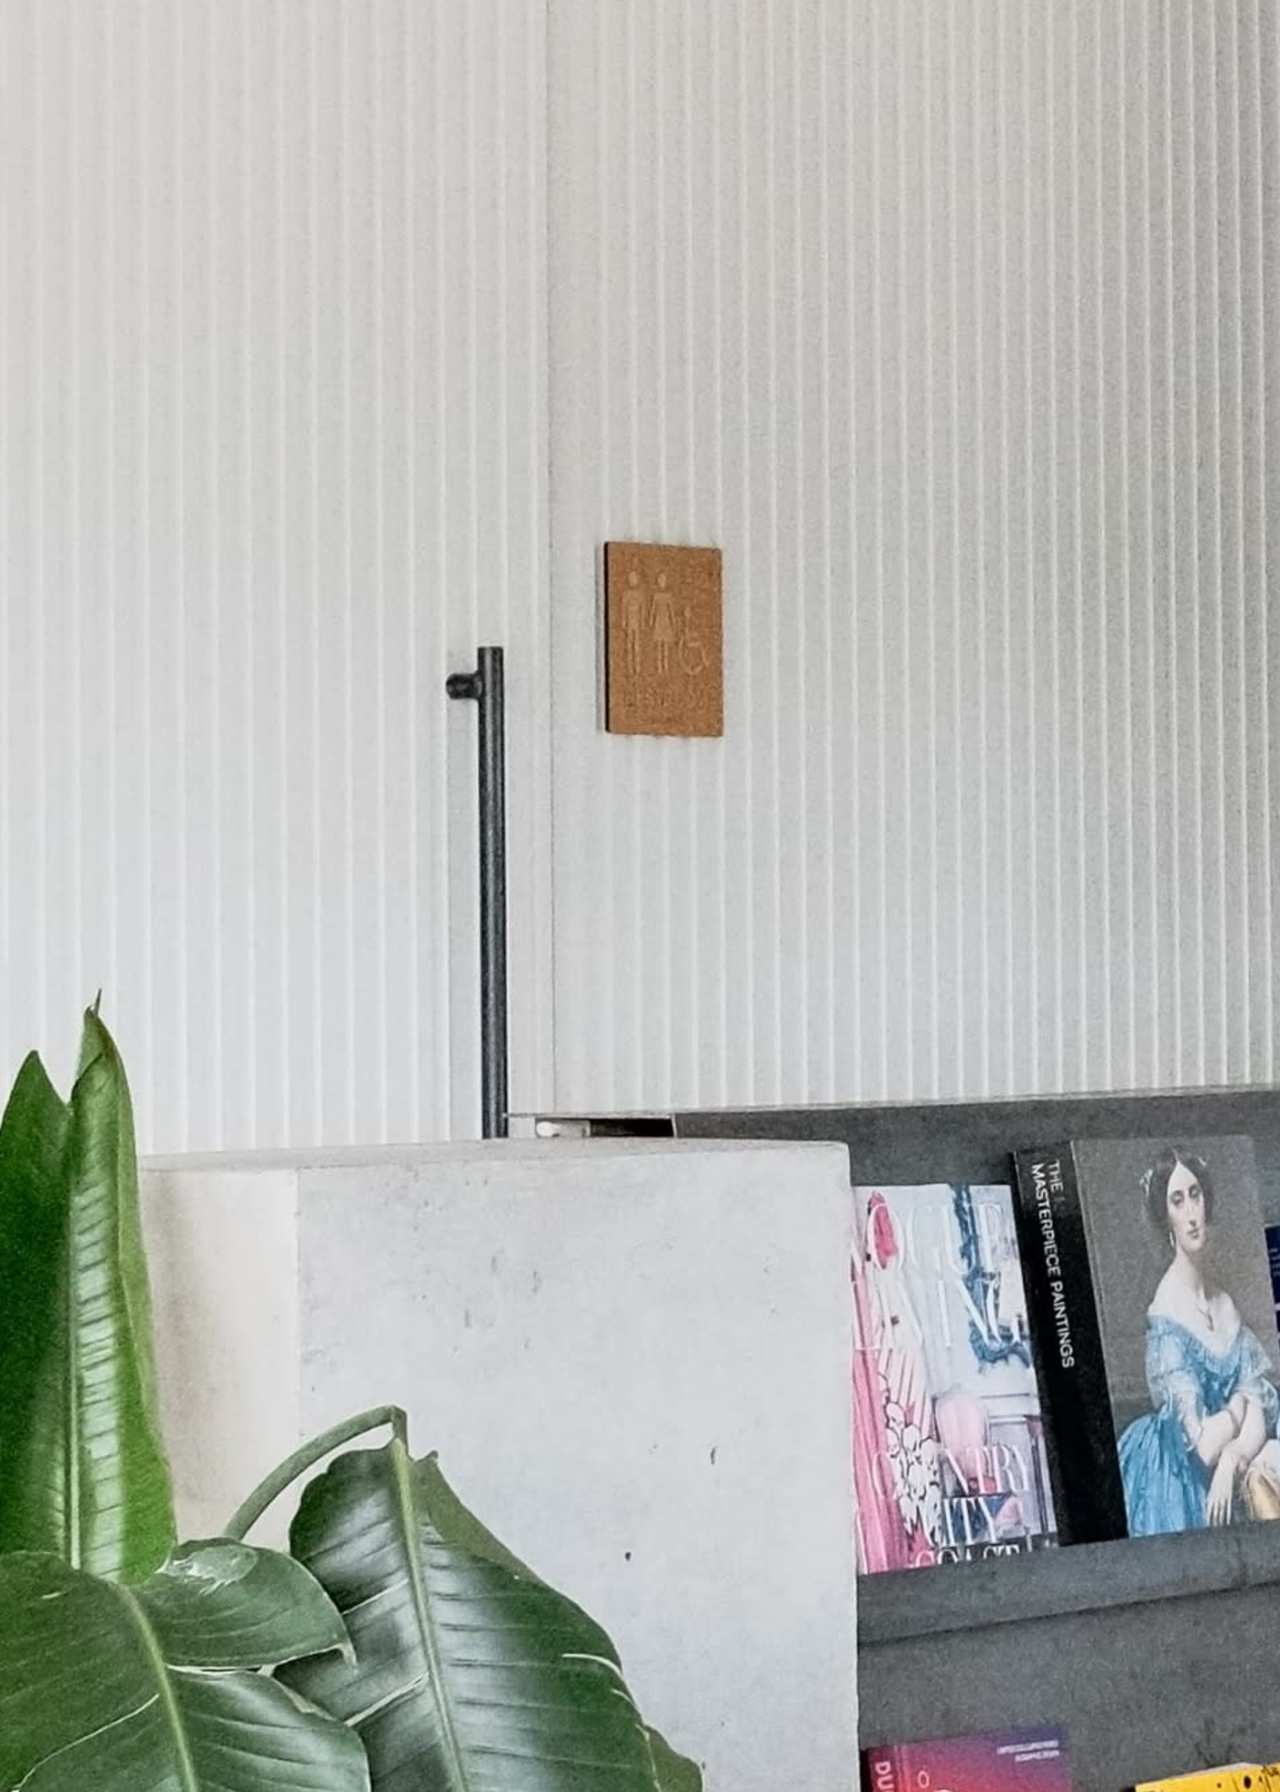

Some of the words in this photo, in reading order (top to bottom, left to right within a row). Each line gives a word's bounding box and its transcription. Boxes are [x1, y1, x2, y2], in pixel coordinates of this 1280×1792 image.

[1048, 1159, 1065, 1194] THE
[1031, 1162, 1062, 1277] MASTERPIECE
[1050, 1280, 1076, 1369] PAINTINGS
